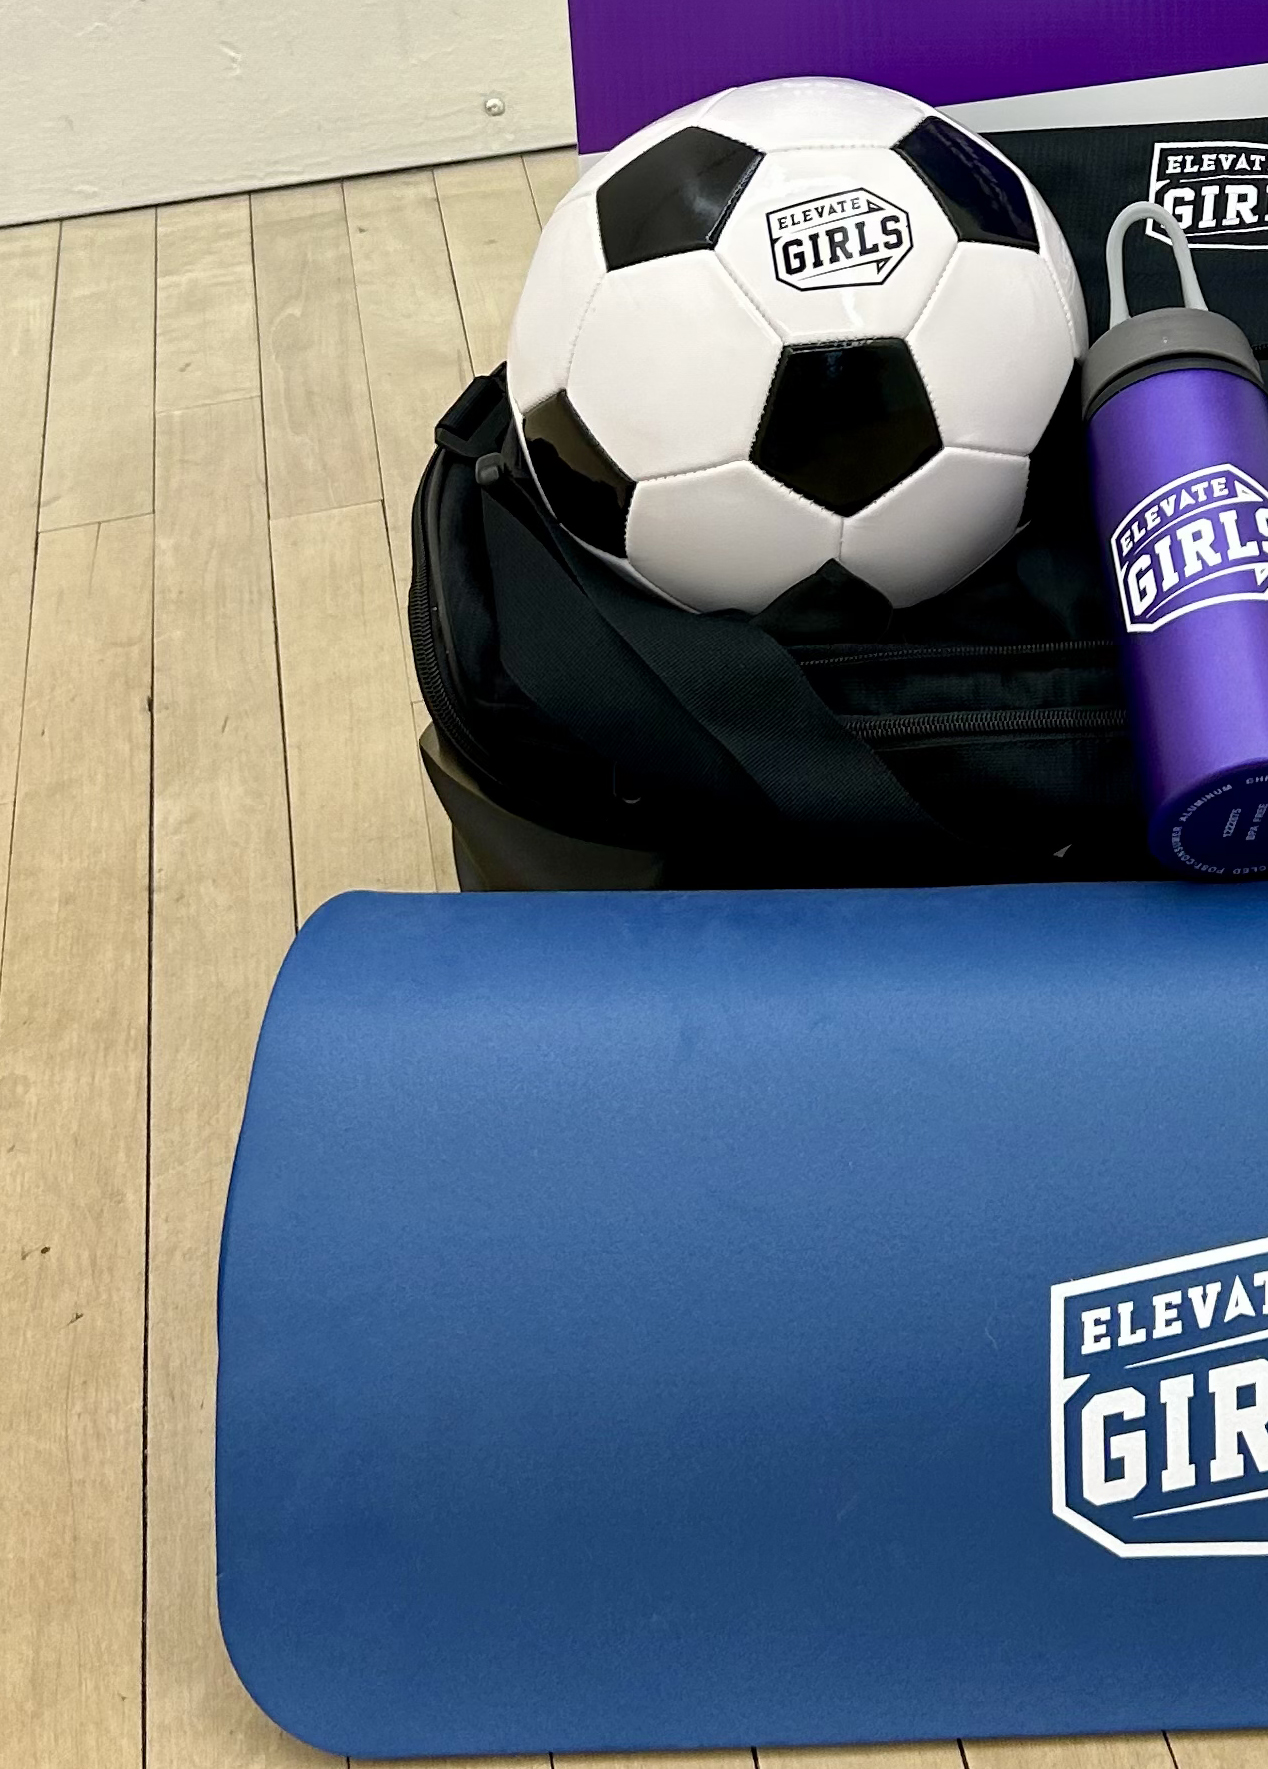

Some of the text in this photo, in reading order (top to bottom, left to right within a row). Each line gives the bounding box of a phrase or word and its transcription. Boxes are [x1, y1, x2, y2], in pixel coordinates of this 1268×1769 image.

[777, 197, 861, 230] ELEVATE
[782, 215, 904, 275] GIRLS
[1120, 477, 1229, 557] ELEVATE
[1179, 784, 1233, 822] ALUMINUM
